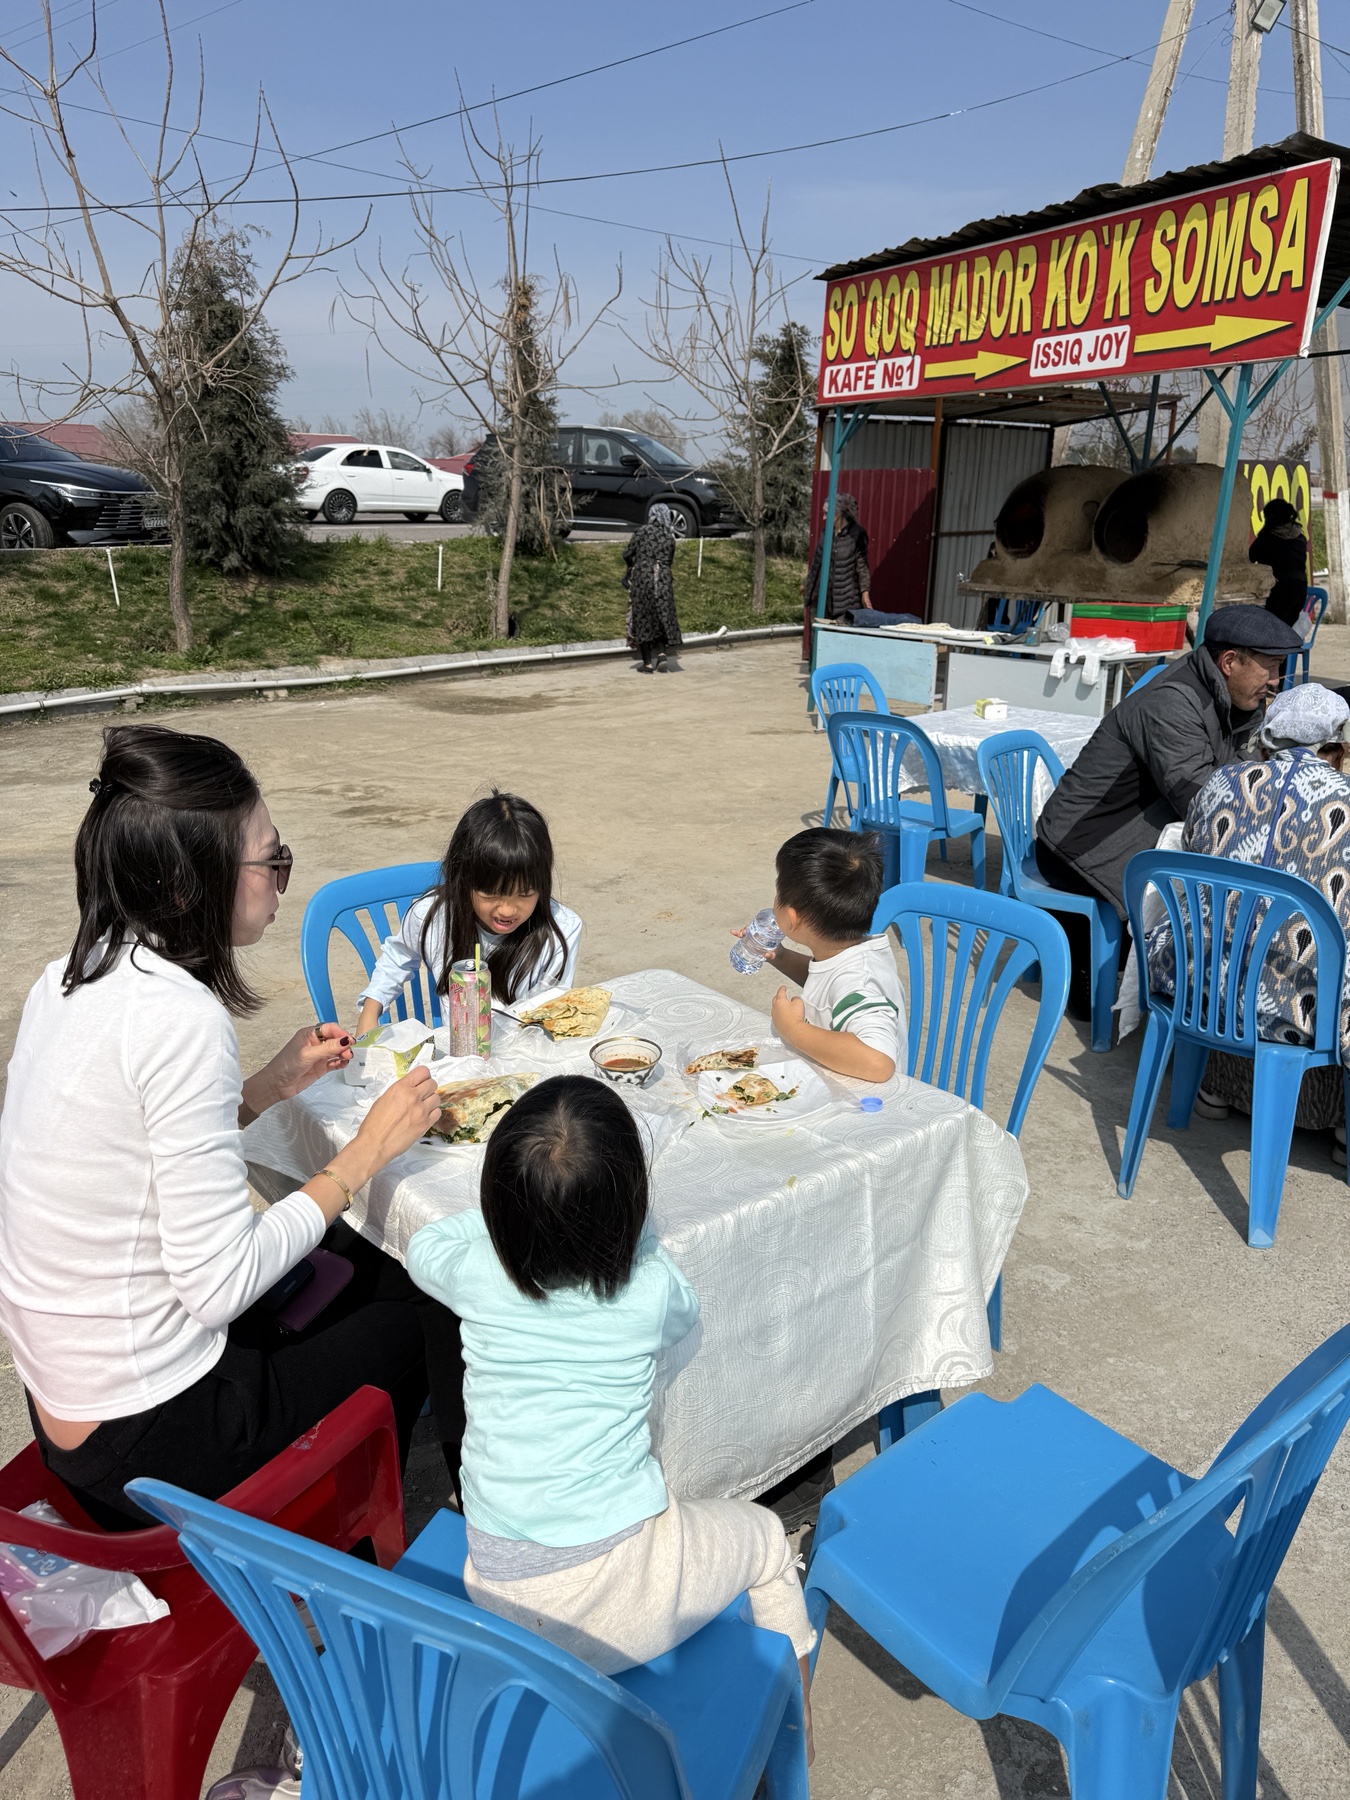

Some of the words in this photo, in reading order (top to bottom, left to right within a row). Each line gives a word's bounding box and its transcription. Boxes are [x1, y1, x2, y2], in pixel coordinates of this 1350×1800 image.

[924, 244, 1038, 348] MADOR
[1144, 177, 1309, 314] SOMSA
[1034, 338, 1083, 370] ISSIQ
[1087, 331, 1128, 362] JOY
[827, 364, 876, 394] KAFE
